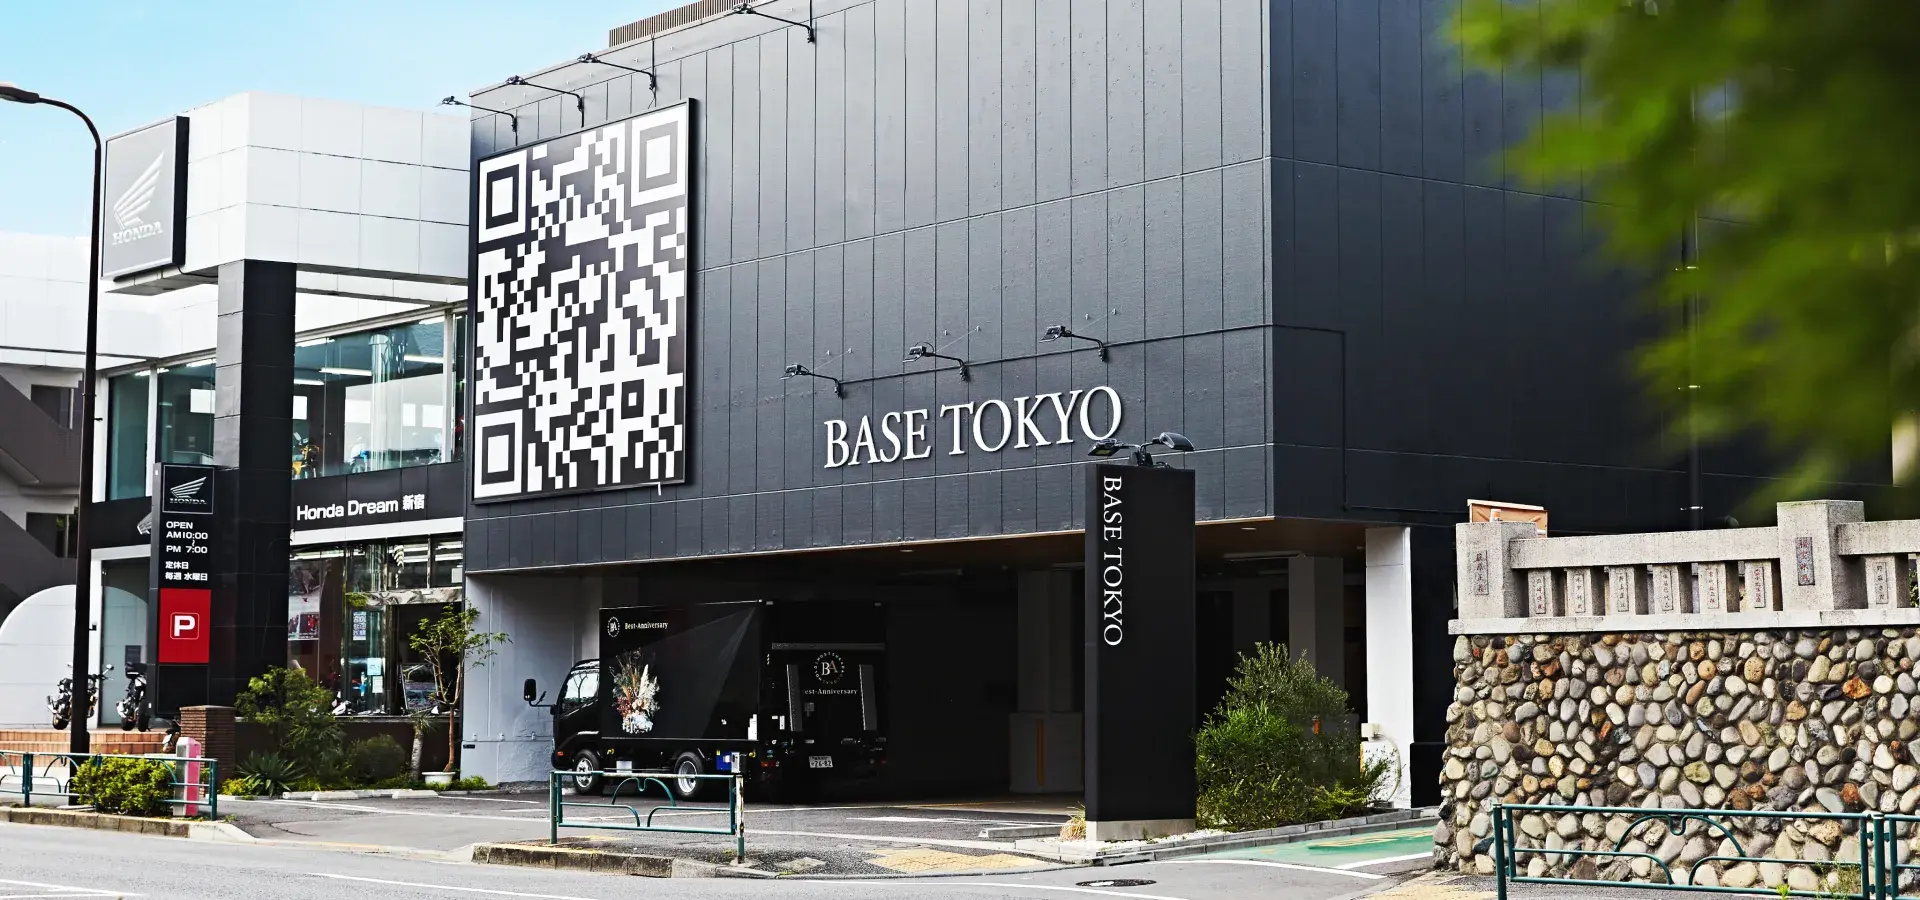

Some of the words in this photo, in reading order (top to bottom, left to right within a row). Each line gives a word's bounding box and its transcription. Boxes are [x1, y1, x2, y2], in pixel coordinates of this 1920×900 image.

[112, 221, 163, 246] HONDA
[824, 408, 932, 469] BASE
[939, 386, 1123, 456] TOKYO
[296, 503, 344, 521] Honda
[347, 499, 399, 516] Dream
[402, 493, 425, 511] 新宿
[1103, 475, 1122, 541] BASE
[166, 521, 193, 529] OPEN
[166, 545, 181, 553] PM
[185, 546, 208, 554] 7:00
[165, 561, 189, 570] 定休日
[165, 572, 182, 581] 毎週
[184, 572, 208, 581] 水曜日
[1103, 547, 1123, 646] TOKYO
[174, 615, 195, 636] P
